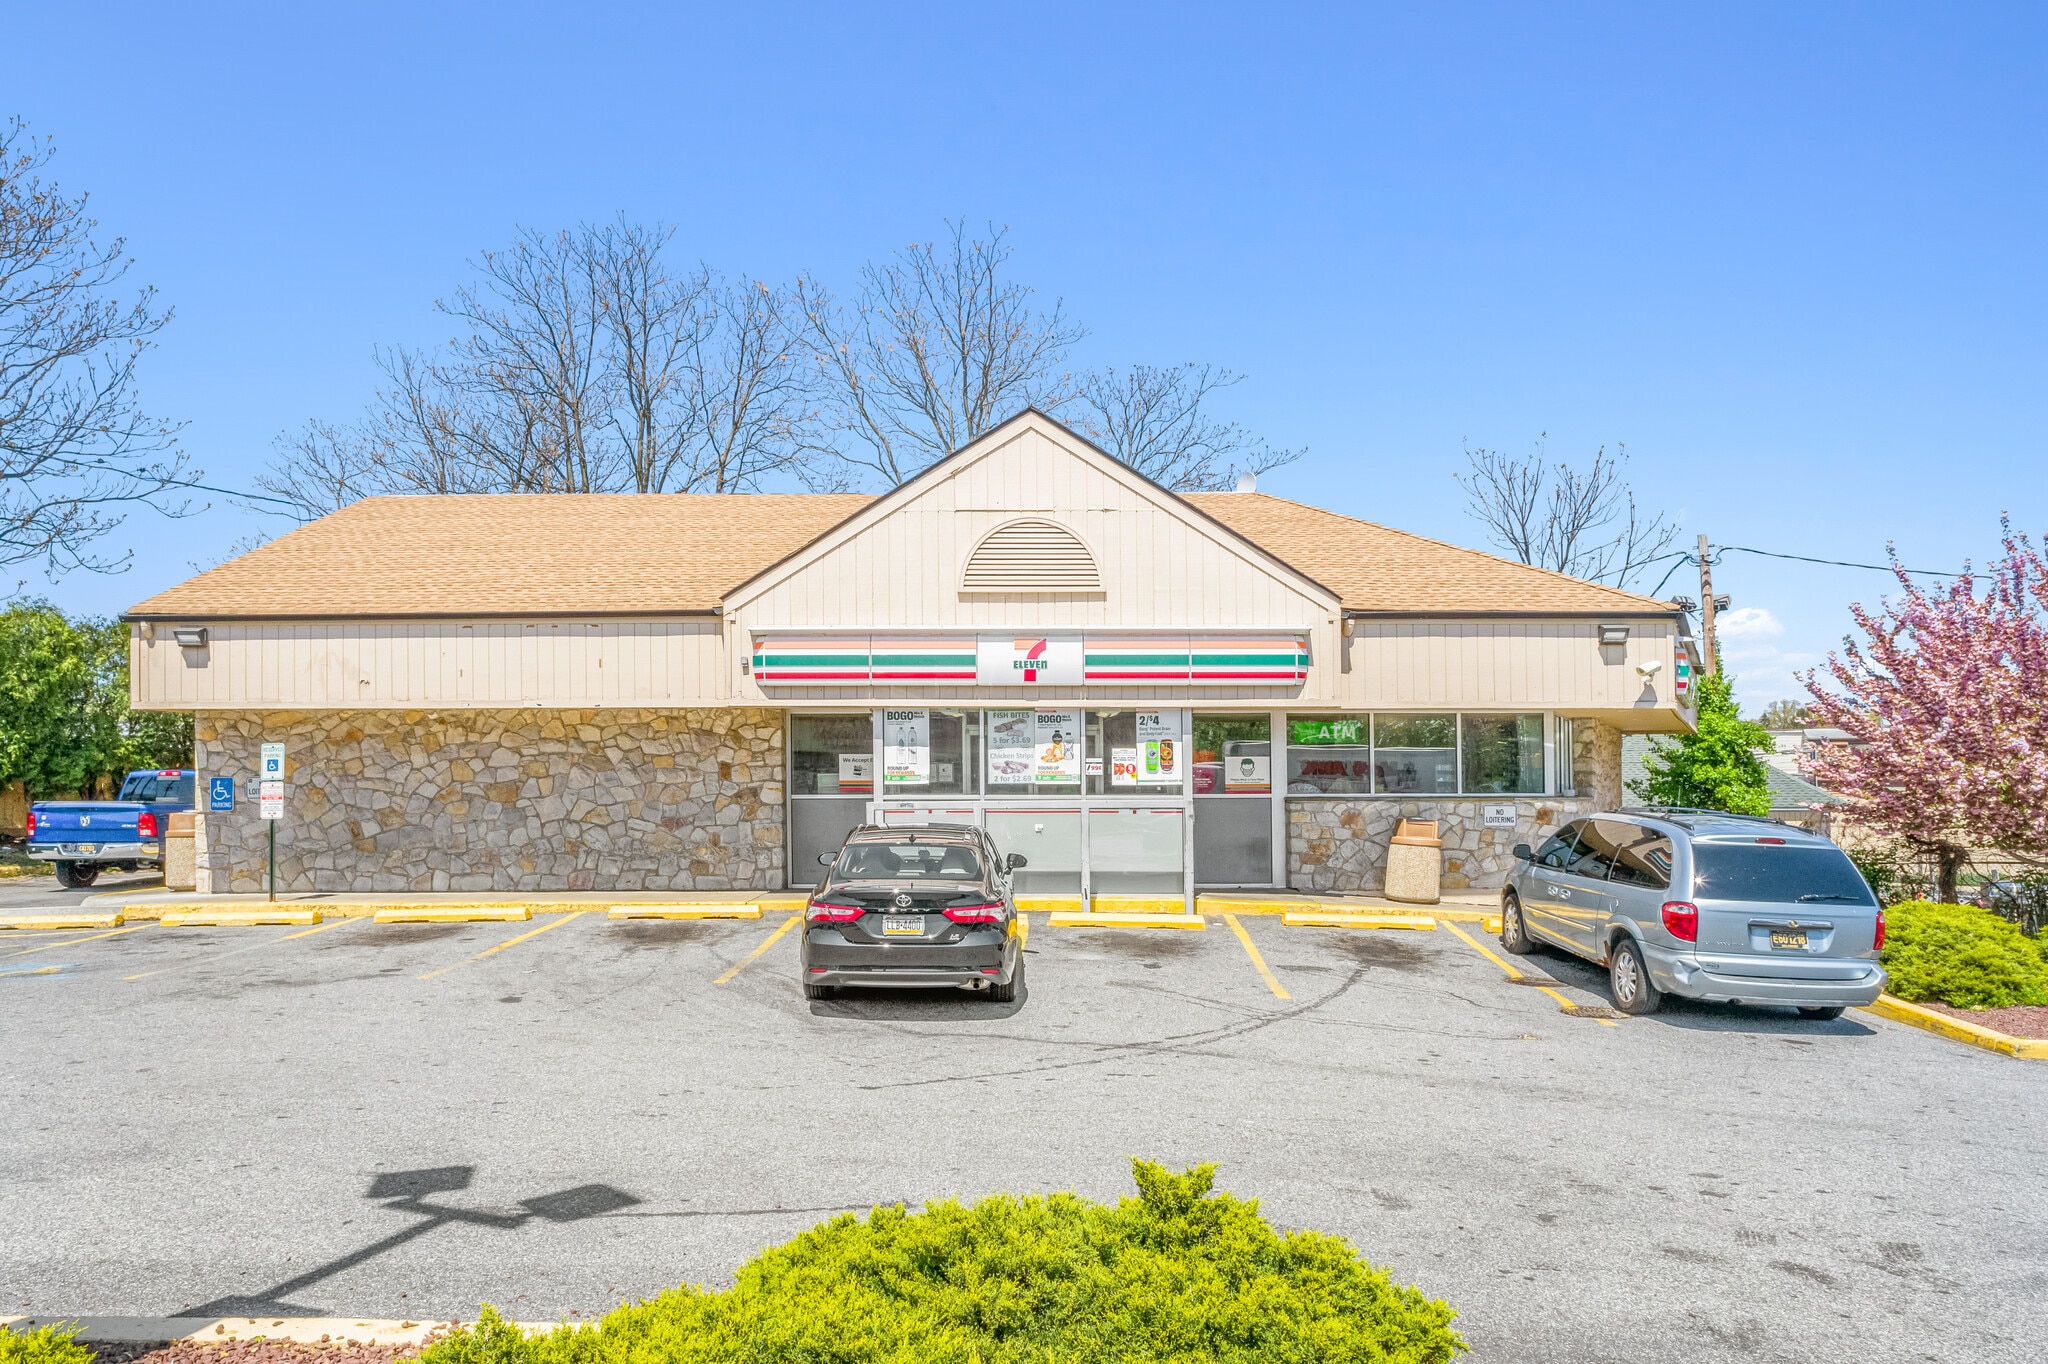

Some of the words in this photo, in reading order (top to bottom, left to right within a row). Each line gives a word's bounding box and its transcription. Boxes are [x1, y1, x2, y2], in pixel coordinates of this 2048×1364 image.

[1013, 638, 1047, 682] 7
[886, 711, 914, 721] BOGO
[1037, 714, 1062, 723] BOGO
[1318, 725, 1356, 740] ATM
[999, 736, 1010, 744] for
[1011, 736, 1031, 745] $3.69
[1016, 752, 1034, 760] Strips
